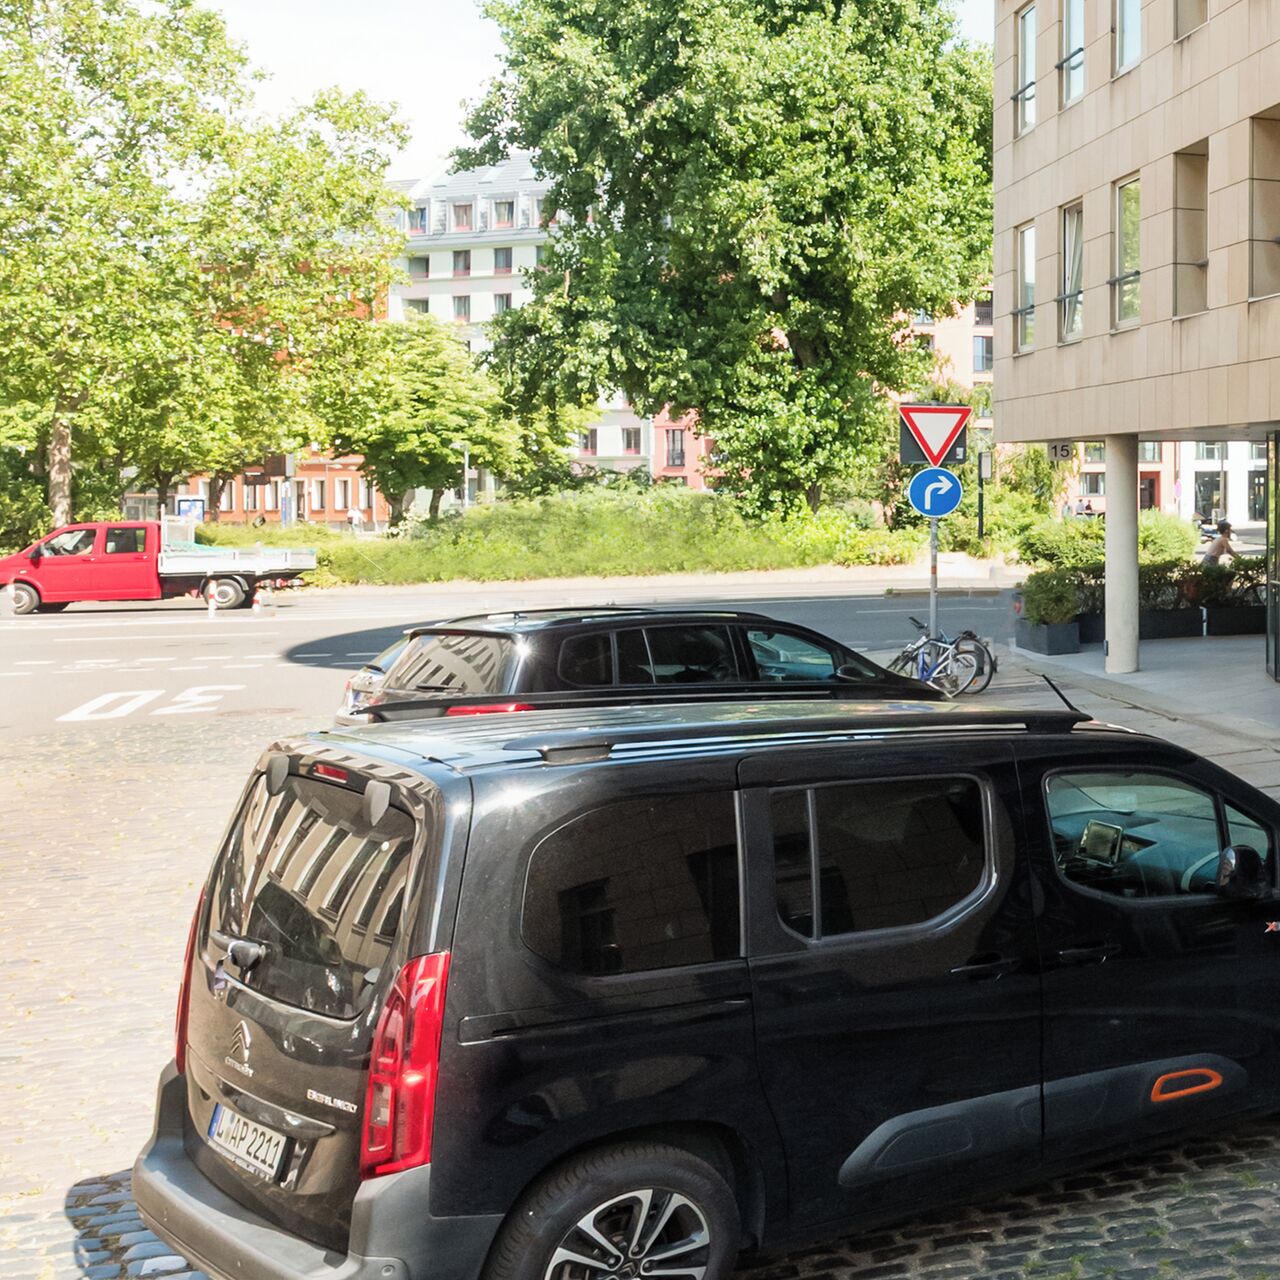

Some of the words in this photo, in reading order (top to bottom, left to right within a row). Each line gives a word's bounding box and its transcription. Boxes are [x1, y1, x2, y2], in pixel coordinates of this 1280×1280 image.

[1051, 444, 1070, 458] 15
[231, 1118, 249, 1151] AP
[246, 1128, 281, 1170] 2211
